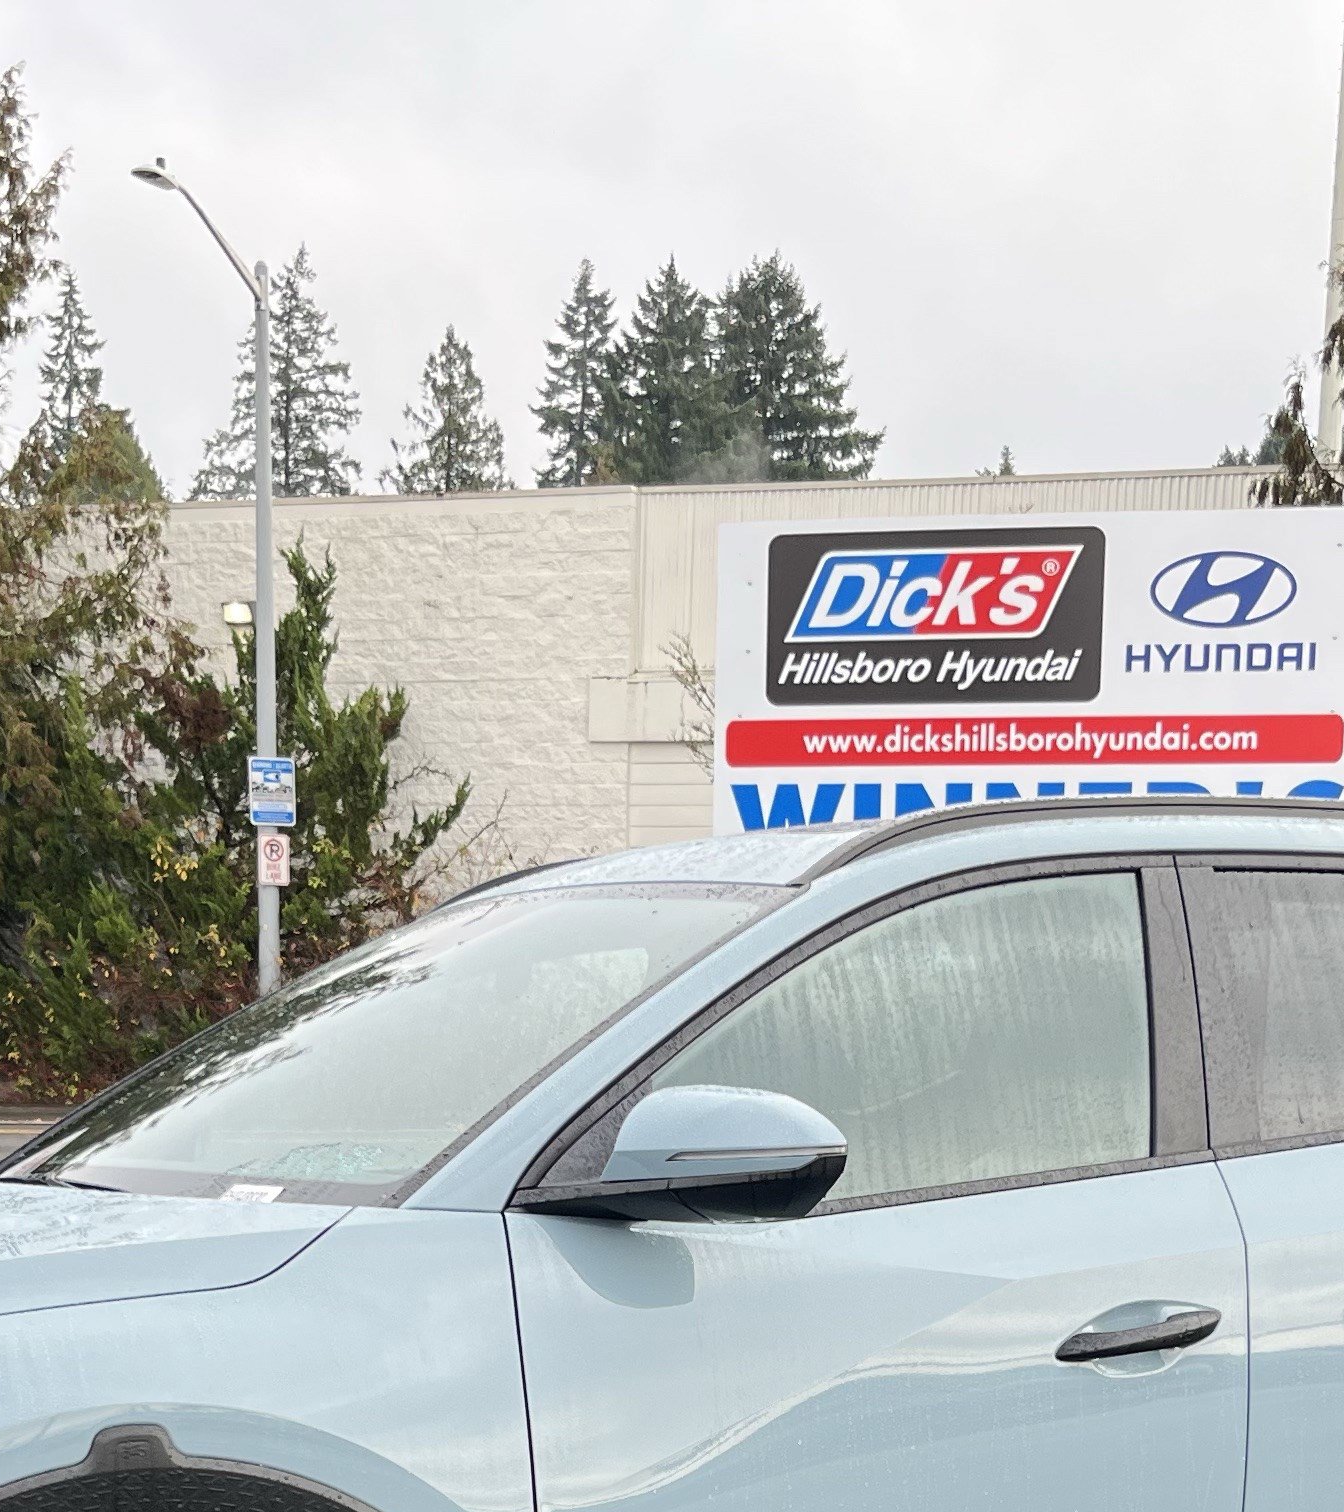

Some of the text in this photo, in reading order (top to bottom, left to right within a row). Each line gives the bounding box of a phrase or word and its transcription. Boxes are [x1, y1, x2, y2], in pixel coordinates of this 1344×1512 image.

[808, 556, 1045, 629] Dick's
[777, 648, 1083, 691] Hillsboro Hyundai
[1125, 642, 1317, 673] HYUNDAI
[802, 720, 1259, 759] www.dickshillsborohyundai.com
